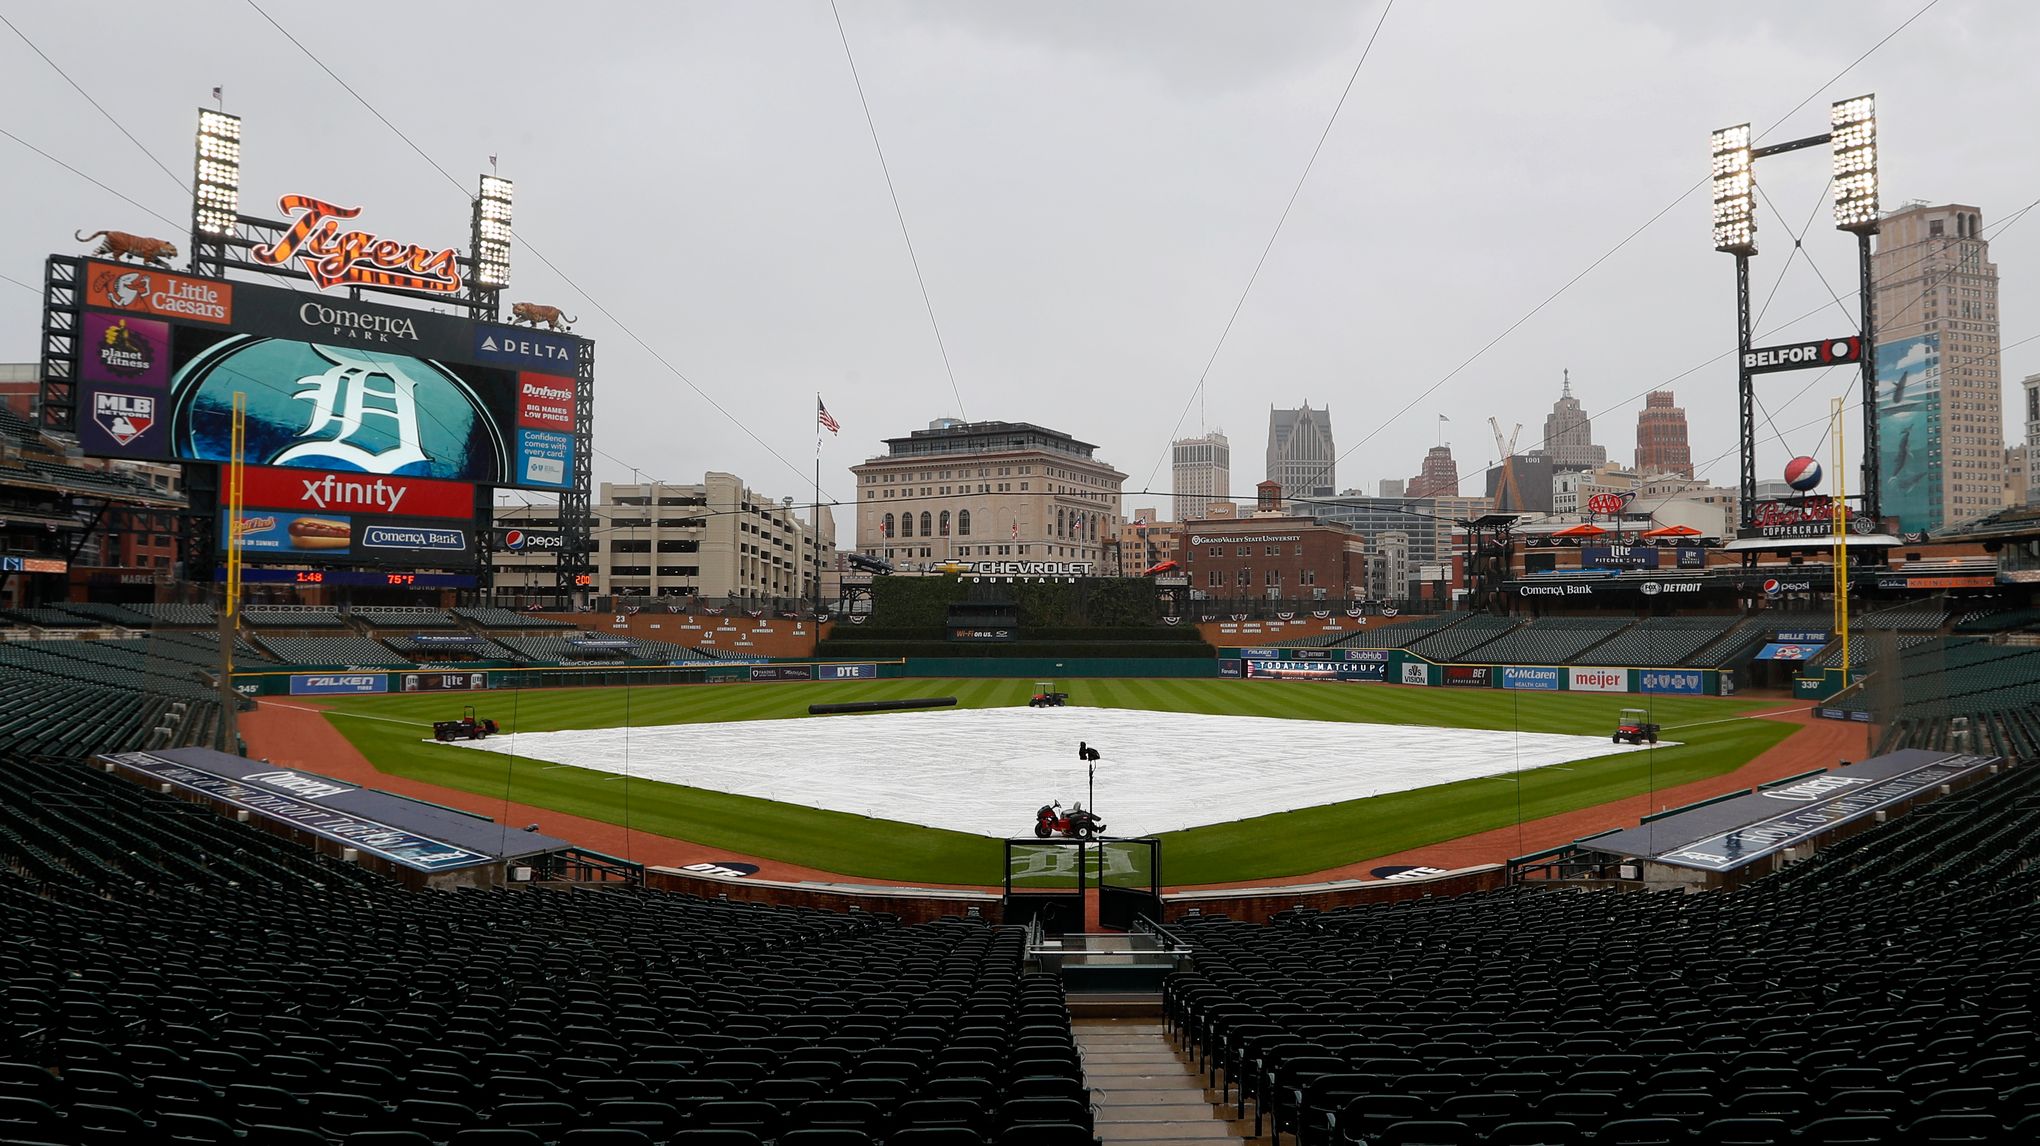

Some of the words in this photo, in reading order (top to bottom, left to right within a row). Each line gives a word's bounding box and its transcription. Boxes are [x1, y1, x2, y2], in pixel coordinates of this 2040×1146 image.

[251, 193, 462, 292] Tigers
[167, 279, 218, 304] Little
[151, 291, 225, 319] Caesars
[300, 302, 419, 341] Comerica
[333, 326, 389, 342] PARK
[101, 348, 142, 360] planet
[504, 339, 569, 361] DELTA
[106, 355, 150, 369] fitness
[1745, 346, 1817, 368] BELFOR
[522, 383, 572, 399] Dunham's
[98, 395, 151, 413] MLB
[541, 405, 568, 415] NAMES
[97, 409, 150, 418] NETWORK
[542, 413, 569, 422] PRICES
[524, 431, 567, 443] Confidence
[524, 441, 549, 449] comes
[550, 442, 566, 450] with
[524, 449, 545, 457] every
[301, 475, 407, 512] xfinity
[1590, 495, 1622, 511] AAA
[1763, 524, 1832, 536] COPPERCRAFT
[371, 531, 427, 544] Comerica
[429, 533, 457, 545] Bank
[527, 535, 563, 549] pepsi
[1611, 545, 1631, 558] Lite
[979, 562, 1093, 574] CHEVROLET
[297, 573, 323, 583] 1:48
[1520, 585, 1565, 596] Comerica
[1567, 584, 1592, 594] Bank
[1663, 583, 1702, 593] DETROIT
[1781, 581, 1810, 591] pepsi
[615, 615, 625, 623] 23
[1351, 651, 1382, 660] StubHub
[837, 666, 859, 677] DTE
[1260, 662, 1309, 670] TODAY'S
[1317, 663, 1376, 672] MATCHUP
[1404, 676, 1425, 684] VISION
[1519, 669, 1556, 679] McLaren
[1576, 671, 1620, 688] meijer
[307, 677, 374, 687] FALKEN
[442, 675, 463, 688] Lite
[1801, 681, 1820, 689] 330'
[239, 794, 331, 820] DETROIT
[1731, 821, 1813, 844] HOME
[682, 863, 747, 878] DTE
